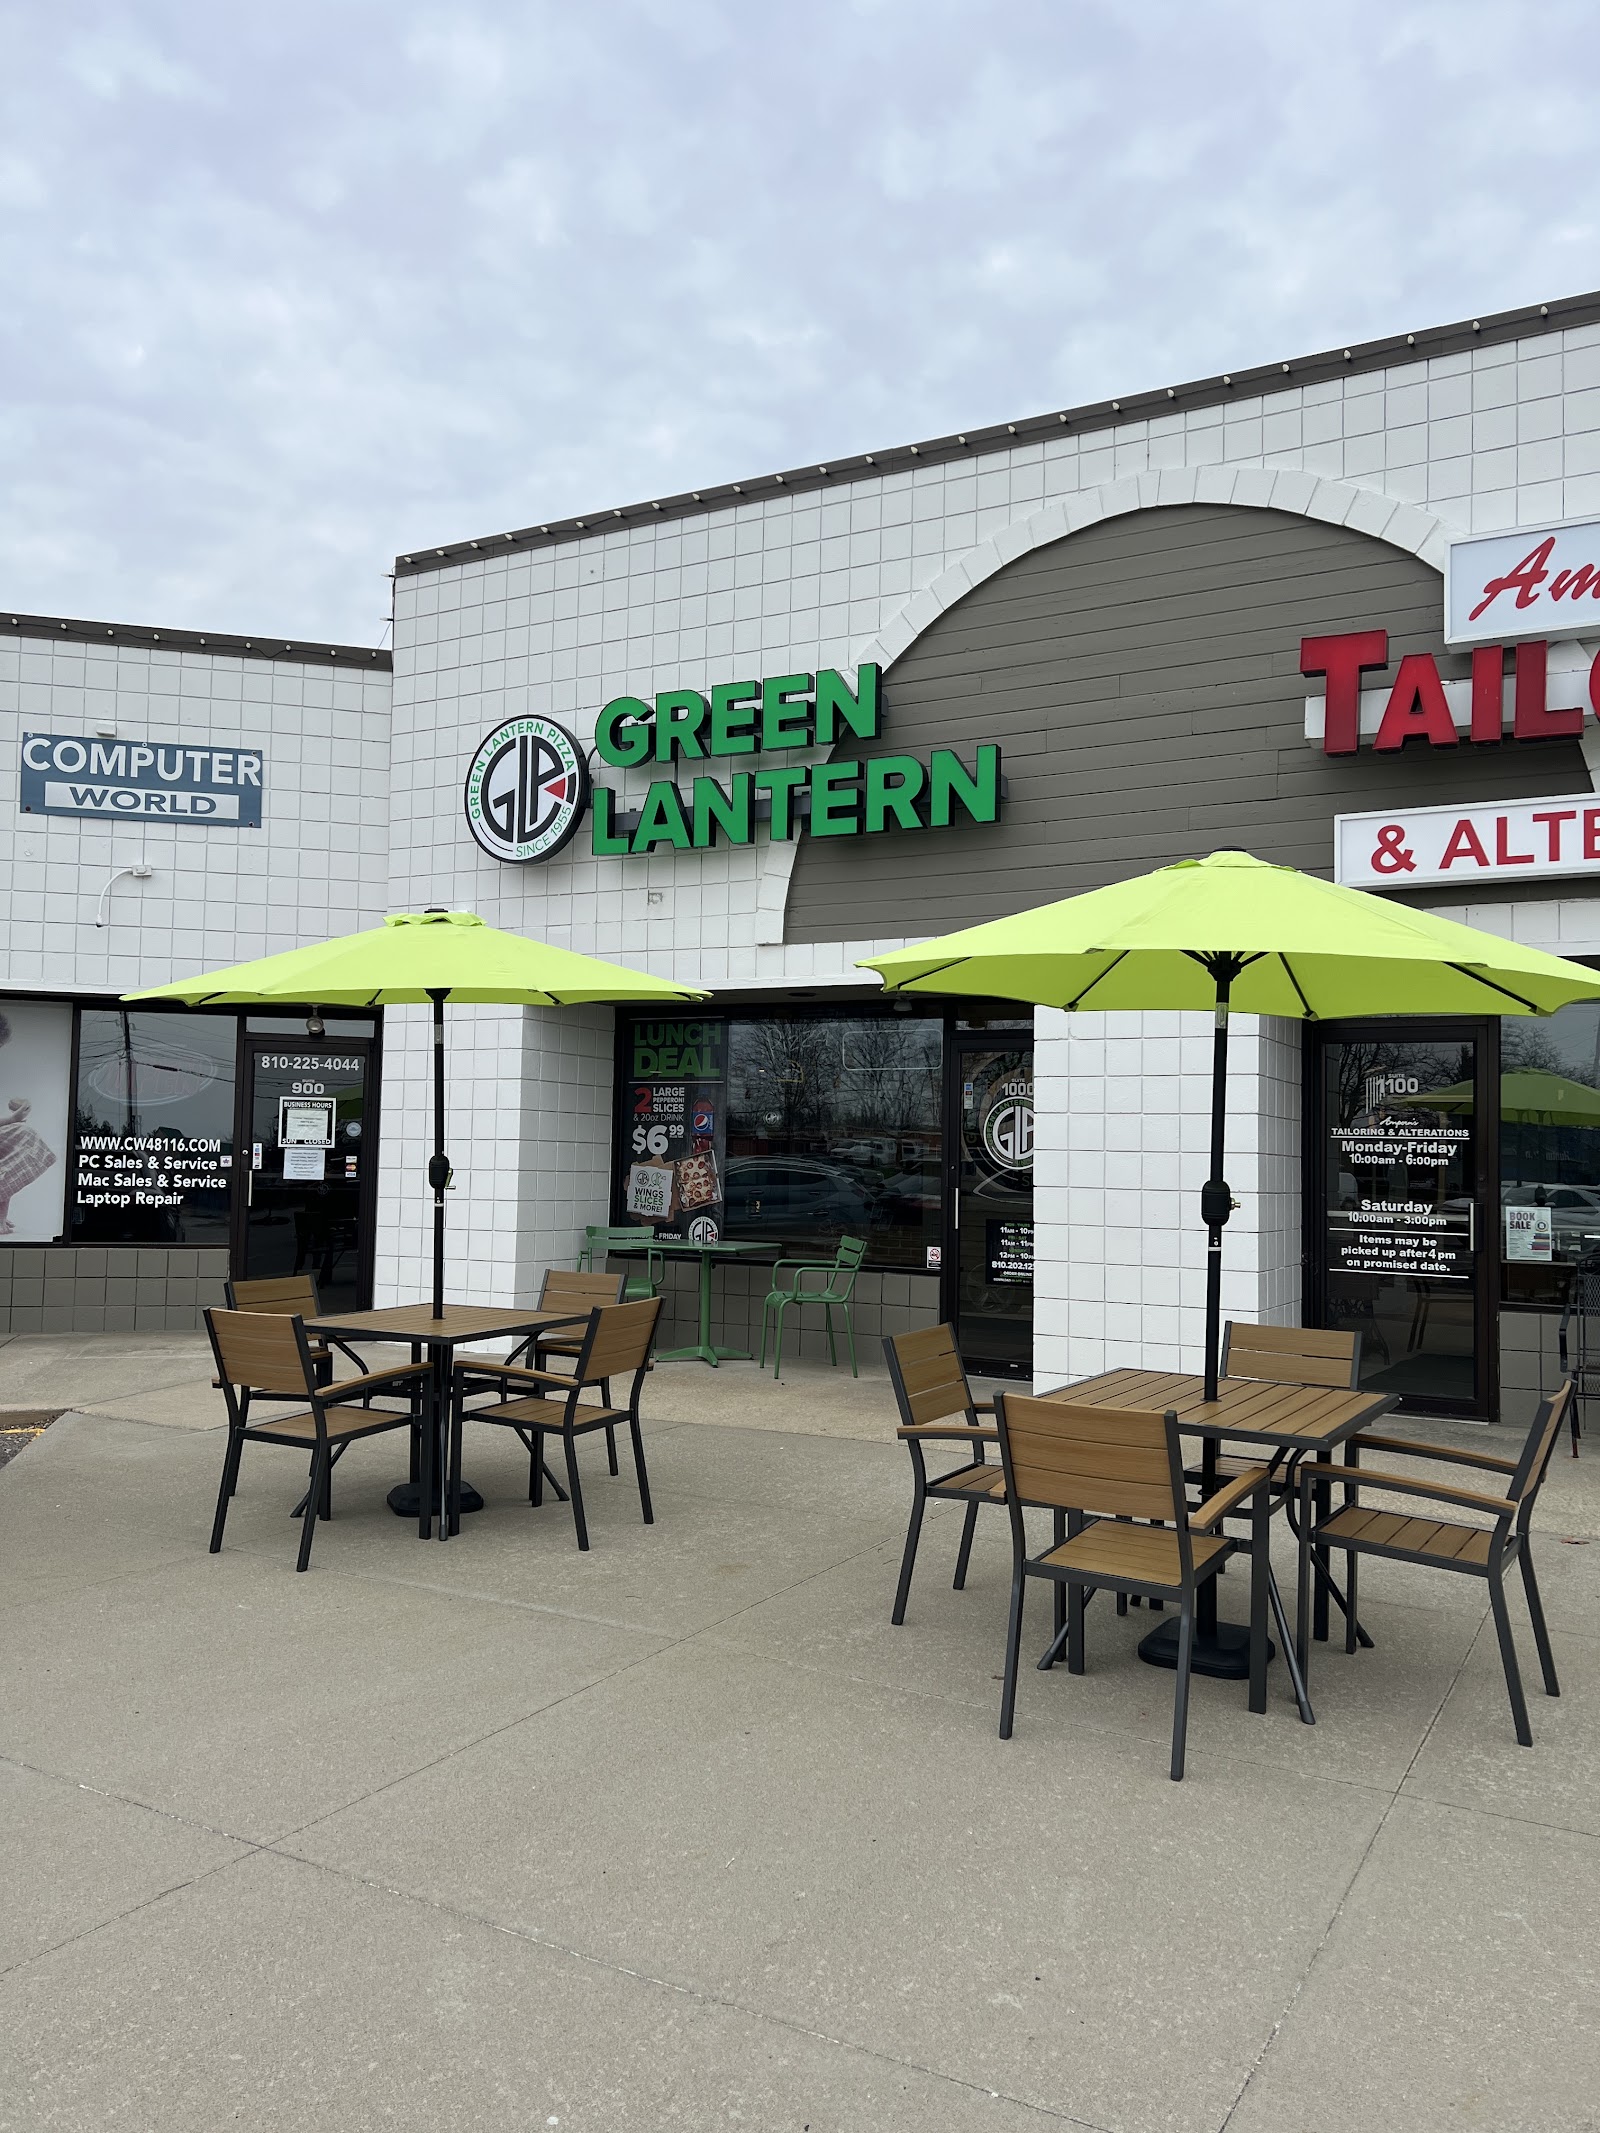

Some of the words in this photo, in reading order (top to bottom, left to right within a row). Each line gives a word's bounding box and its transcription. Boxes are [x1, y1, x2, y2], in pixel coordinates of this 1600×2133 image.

[1300, 629, 1600, 758] TAIL
[594, 662, 882, 768] GREEN
[23, 738, 261, 786] COMPUTER
[470, 760, 486, 820] GREEN
[484, 721, 544, 757] LANTERN
[547, 728, 575, 771] PIZZA
[69, 786, 216, 815] WORLD
[592, 744, 1000, 857] LANTERN
[516, 834, 552, 857] SINCE
[550, 806, 572, 836] 1955
[1371, 824, 1417, 874] &
[634, 1023, 721, 1046] LUNCH
[261, 1055, 359, 1071] 810-225-4044
[634, 1047, 720, 1077] DEAL
[291, 1082, 324, 1095] 900
[634, 1087, 652, 1113] 2
[653, 1087, 685, 1096] LARGE
[653, 1104, 684, 1112] SLICES
[633, 1113, 639, 1121] &
[641, 1113, 659, 1121] 20oz
[1331, 1127, 1385, 1136] TAILORING
[1388, 1128, 1395, 1136] &
[1398, 1129, 1469, 1137] ALTERATIONS
[80, 1136, 221, 1152] WWW.CW48116.COM
[1341, 1140, 1457, 1156] Monday-Friday
[78, 1155, 100, 1168] PC
[104, 1155, 143, 1169] Sales
[147, 1156, 160, 1169] &
[164, 1156, 217, 1170] Service
[1349, 1153, 1396, 1165] 10:00am
[1406, 1154, 1449, 1167] 6:00pm
[78, 1173, 110, 1187] Mac
[113, 1173, 152, 1187] Sales
[157, 1174, 169, 1187] &
[173, 1174, 227, 1188] Service
[77, 1191, 130, 1208] Laptop
[135, 1191, 184, 1208] Repair
[635, 1187, 664, 1198] WINGS
[634, 1195, 664, 1206] SLICES
[1361, 1199, 1433, 1215] Saturday
[640, 1204, 663, 1213] MORE!
[1347, 1211, 1394, 1224] 10:00am
[1404, 1216, 1447, 1227] 3:00pm
[1510, 1212, 1535, 1221] BOOK
[1510, 1221, 1531, 1229] SALE
[659, 1232, 682, 1240] FRIDAY
[1359, 1234, 1392, 1245] Items
[1395, 1237, 1419, 1248] may
[1422, 1237, 1438, 1247] be
[1341, 1245, 1379, 1256] picked
[1382, 1249, 1397, 1258] up
[1399, 1248, 1428, 1258] after
[991, 1261, 1034, 1270] 810.202.12
[1346, 1258, 1361, 1267] on
[1363, 1259, 1417, 1270] promised
[1420, 1261, 1450, 1272] date.
